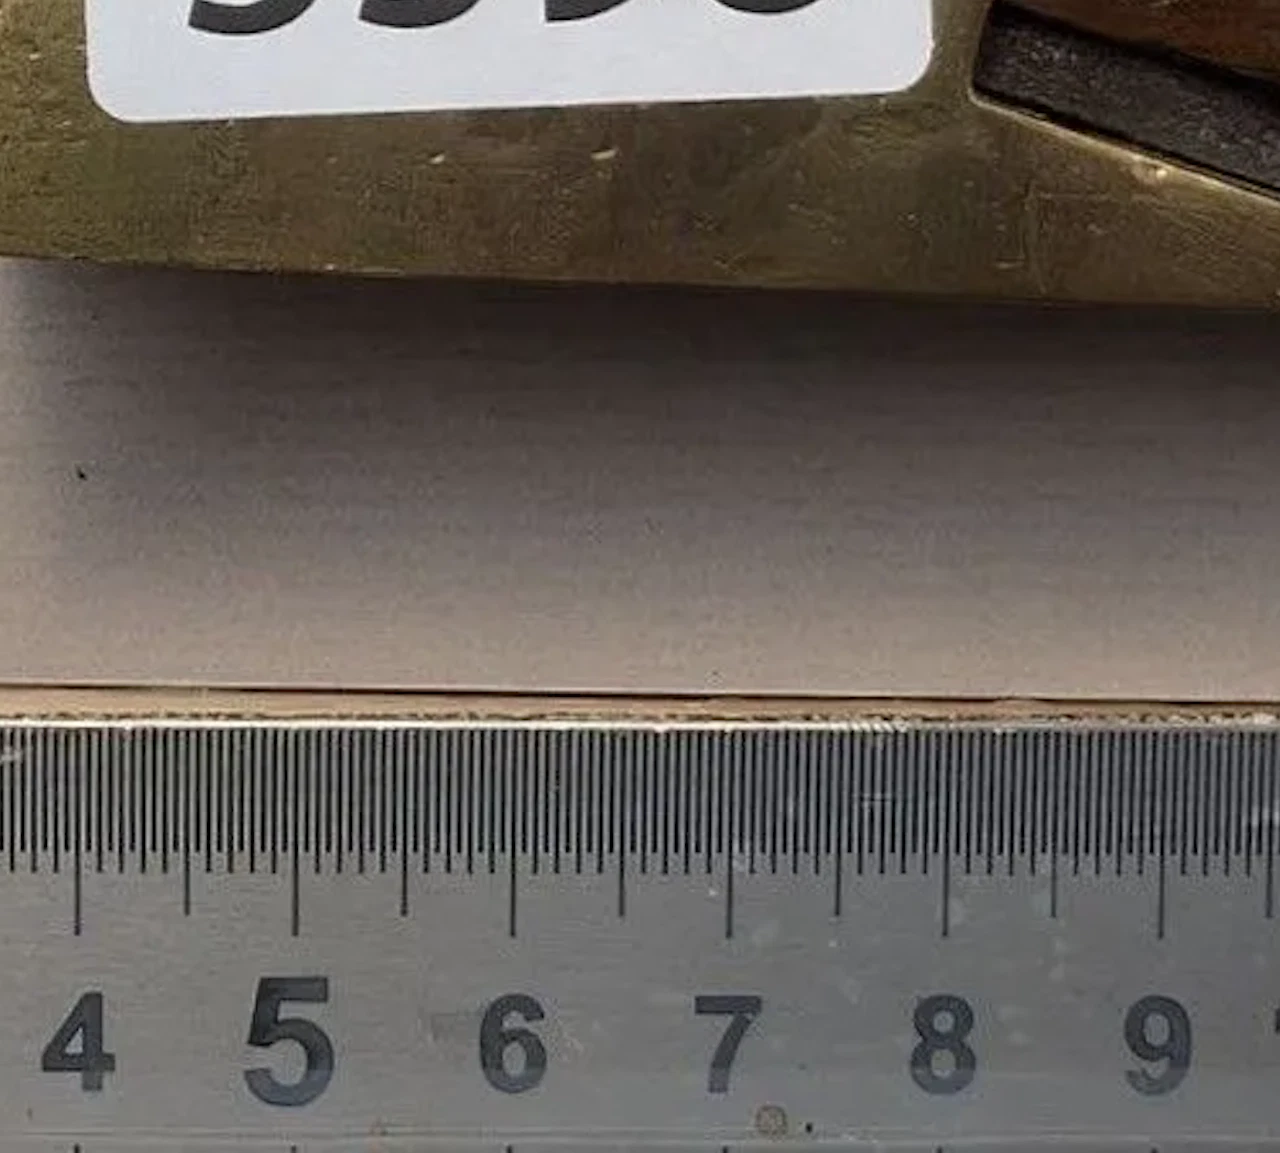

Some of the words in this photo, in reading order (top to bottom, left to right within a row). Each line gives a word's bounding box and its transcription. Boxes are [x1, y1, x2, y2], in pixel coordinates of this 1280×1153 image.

[41, 992, 116, 1092] 4
[244, 977, 335, 1108] 5
[479, 993, 548, 1094] 6
[694, 995, 764, 1093] 7
[910, 994, 977, 1095] 8
[1123, 994, 1193, 1096] 9
